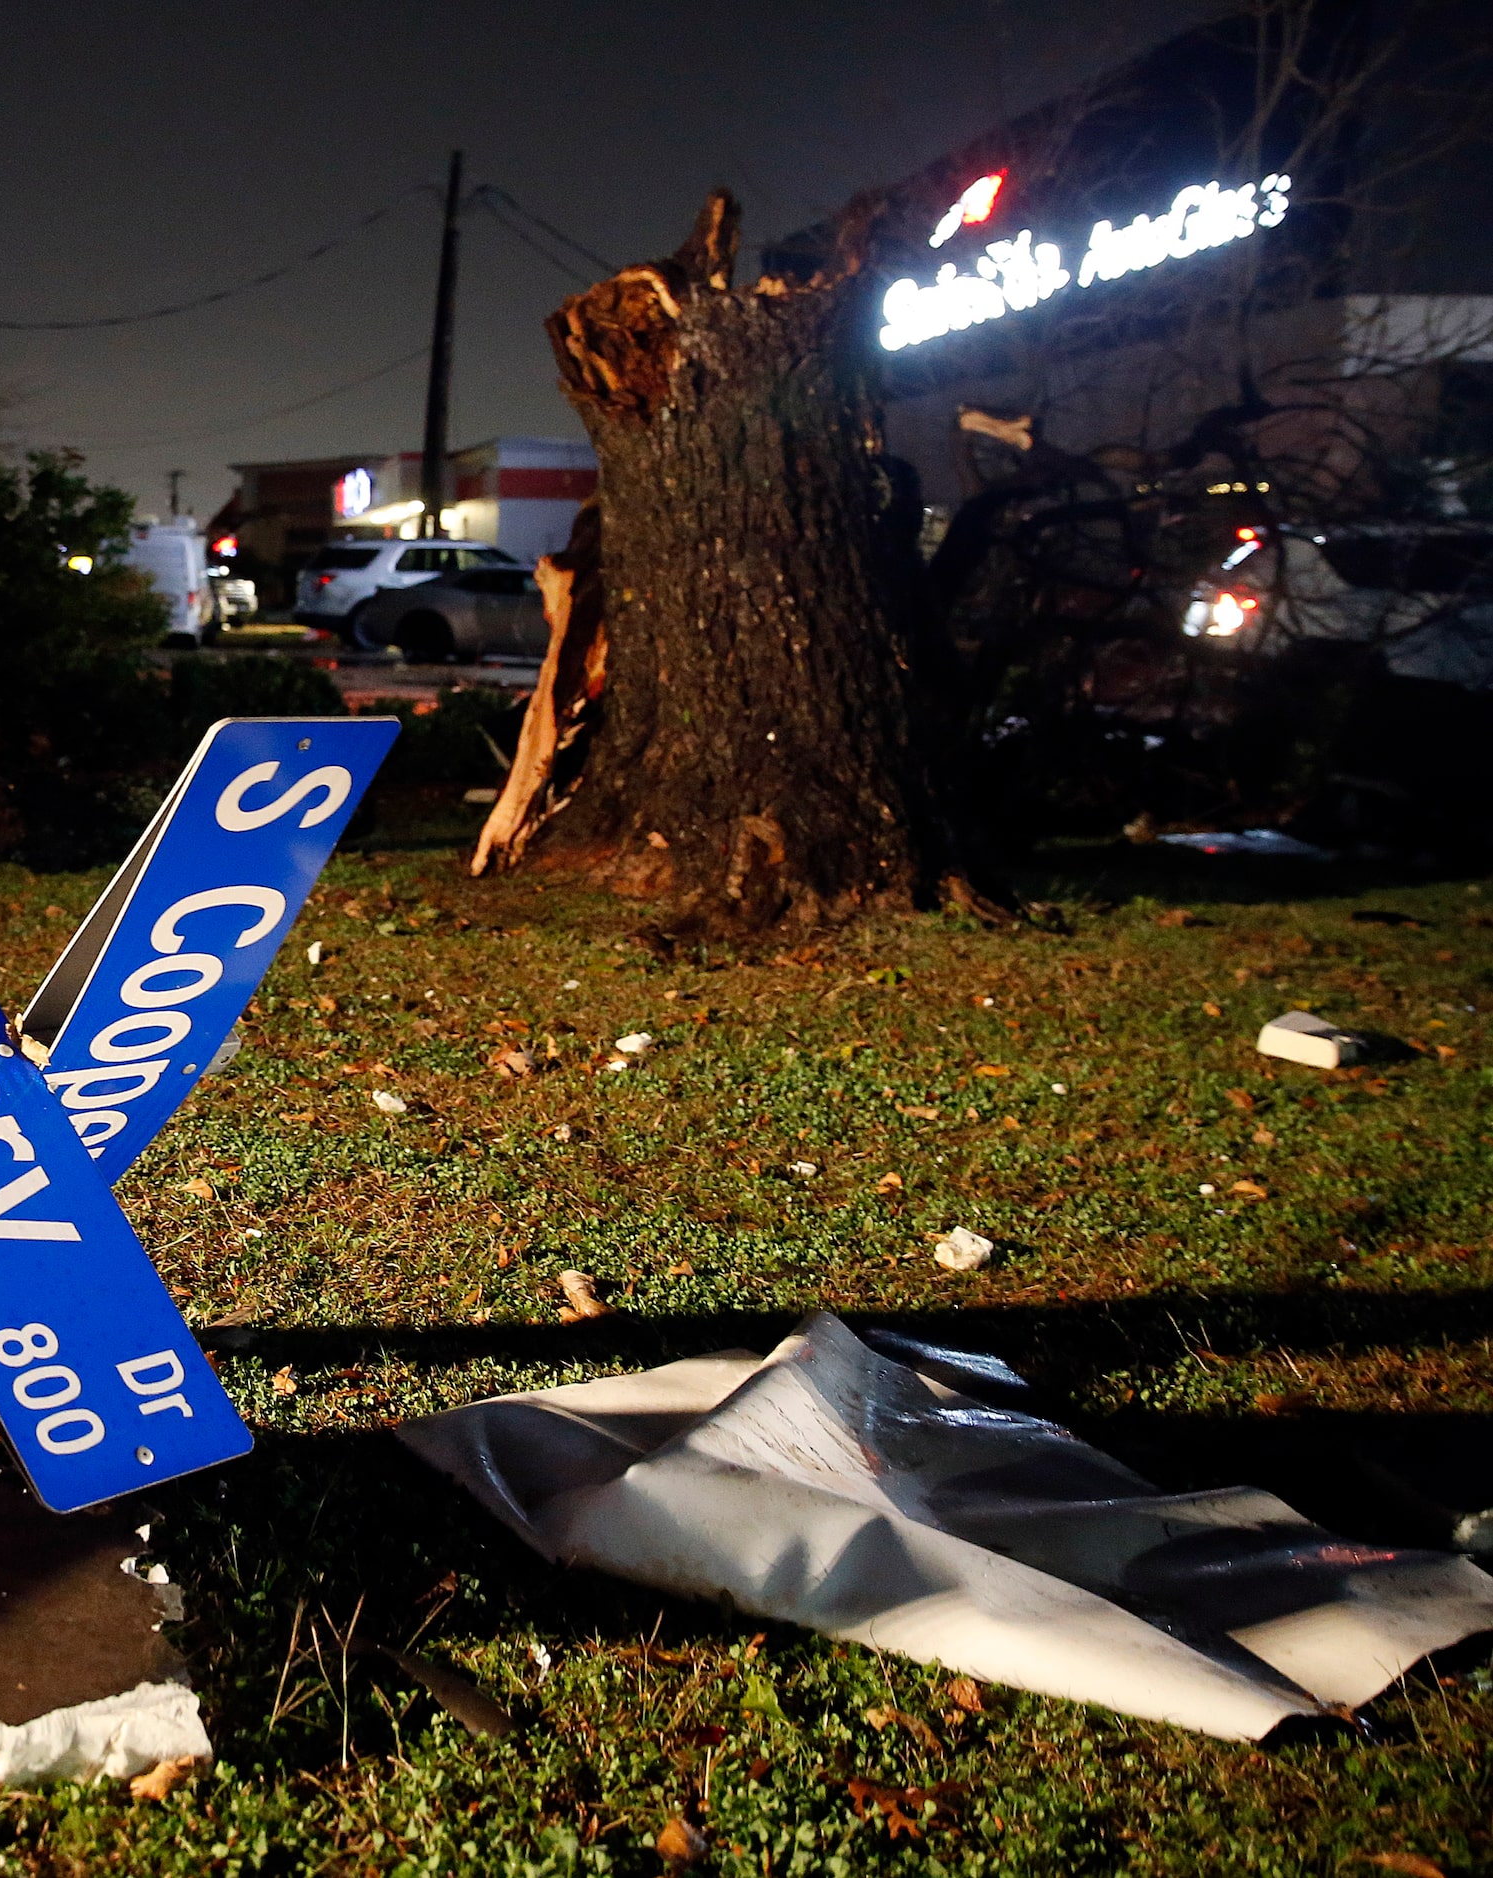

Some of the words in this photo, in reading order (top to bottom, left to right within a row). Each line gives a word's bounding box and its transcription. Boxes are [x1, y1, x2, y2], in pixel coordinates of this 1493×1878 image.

[214, 761, 352, 832] S
[43, 885, 286, 1161] Coope
[115, 1349, 194, 1418] Dr
